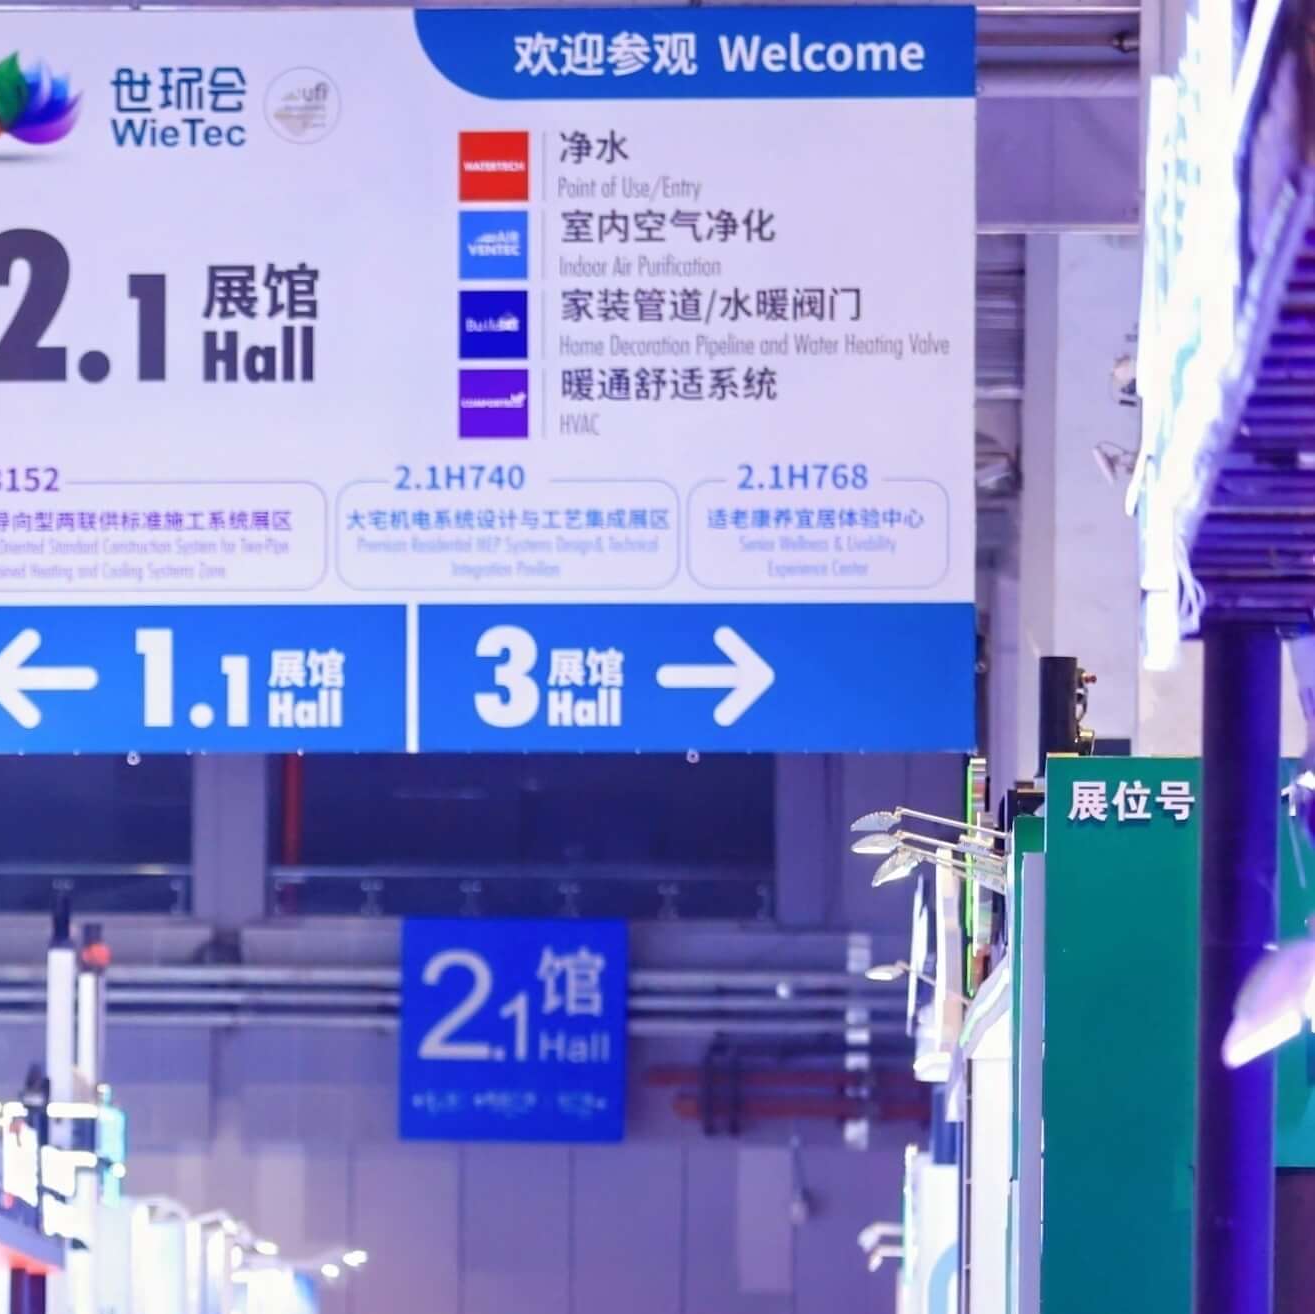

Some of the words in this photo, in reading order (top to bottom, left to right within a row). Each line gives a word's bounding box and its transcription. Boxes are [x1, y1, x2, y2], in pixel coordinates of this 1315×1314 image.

[513, 32, 698, 77] 欢迎参观
[719, 34, 925, 74] Welcome
[110, 66, 247, 114] 世环会
[111, 118, 247, 148] WieTec
[560, 130, 630, 165] 净水
[557, 176, 597, 199] Point
[601, 176, 617, 198] of
[622, 176, 702, 202] Use/Entry
[561, 208, 776, 244] 室内空气净化
[559, 255, 607, 278] Indoor
[612, 255, 633, 277] Air
[637, 254, 722, 278] Purification
[202, 263, 320, 321] 展馆
[560, 287, 862, 324] 家装管道/水暖阀门
[202, 325, 315, 383] Hall
[559, 335, 605, 356] Home
[610, 335, 691, 356] Decoration
[695, 335, 755, 360] Pipeline
[759, 335, 788, 356] and
[793, 335, 840, 356] Water
[844, 335, 903, 360] Heating
[907, 334, 950, 356] Valve
[561, 366, 778, 402] 暖通舒适系统
[559, 414, 601, 436] HVAC
[393, 464, 526, 491] 2.1H740
[736, 463, 869, 491] 2.1H768
[707, 507, 925, 530] 适老康养宜居体验中心
[135, 628, 250, 728] 1.1
[267, 648, 346, 689] 展馆
[473, 624, 540, 728] 3
[548, 647, 624, 690] 展馆
[269, 690, 342, 727] Hall
[548, 690, 622, 727] Hall
[1067, 781, 1196, 823] 展位号
[535, 946, 606, 1016] 馆
[418, 948, 529, 1062] 2.1
[538, 1030, 611, 1063] Hall
